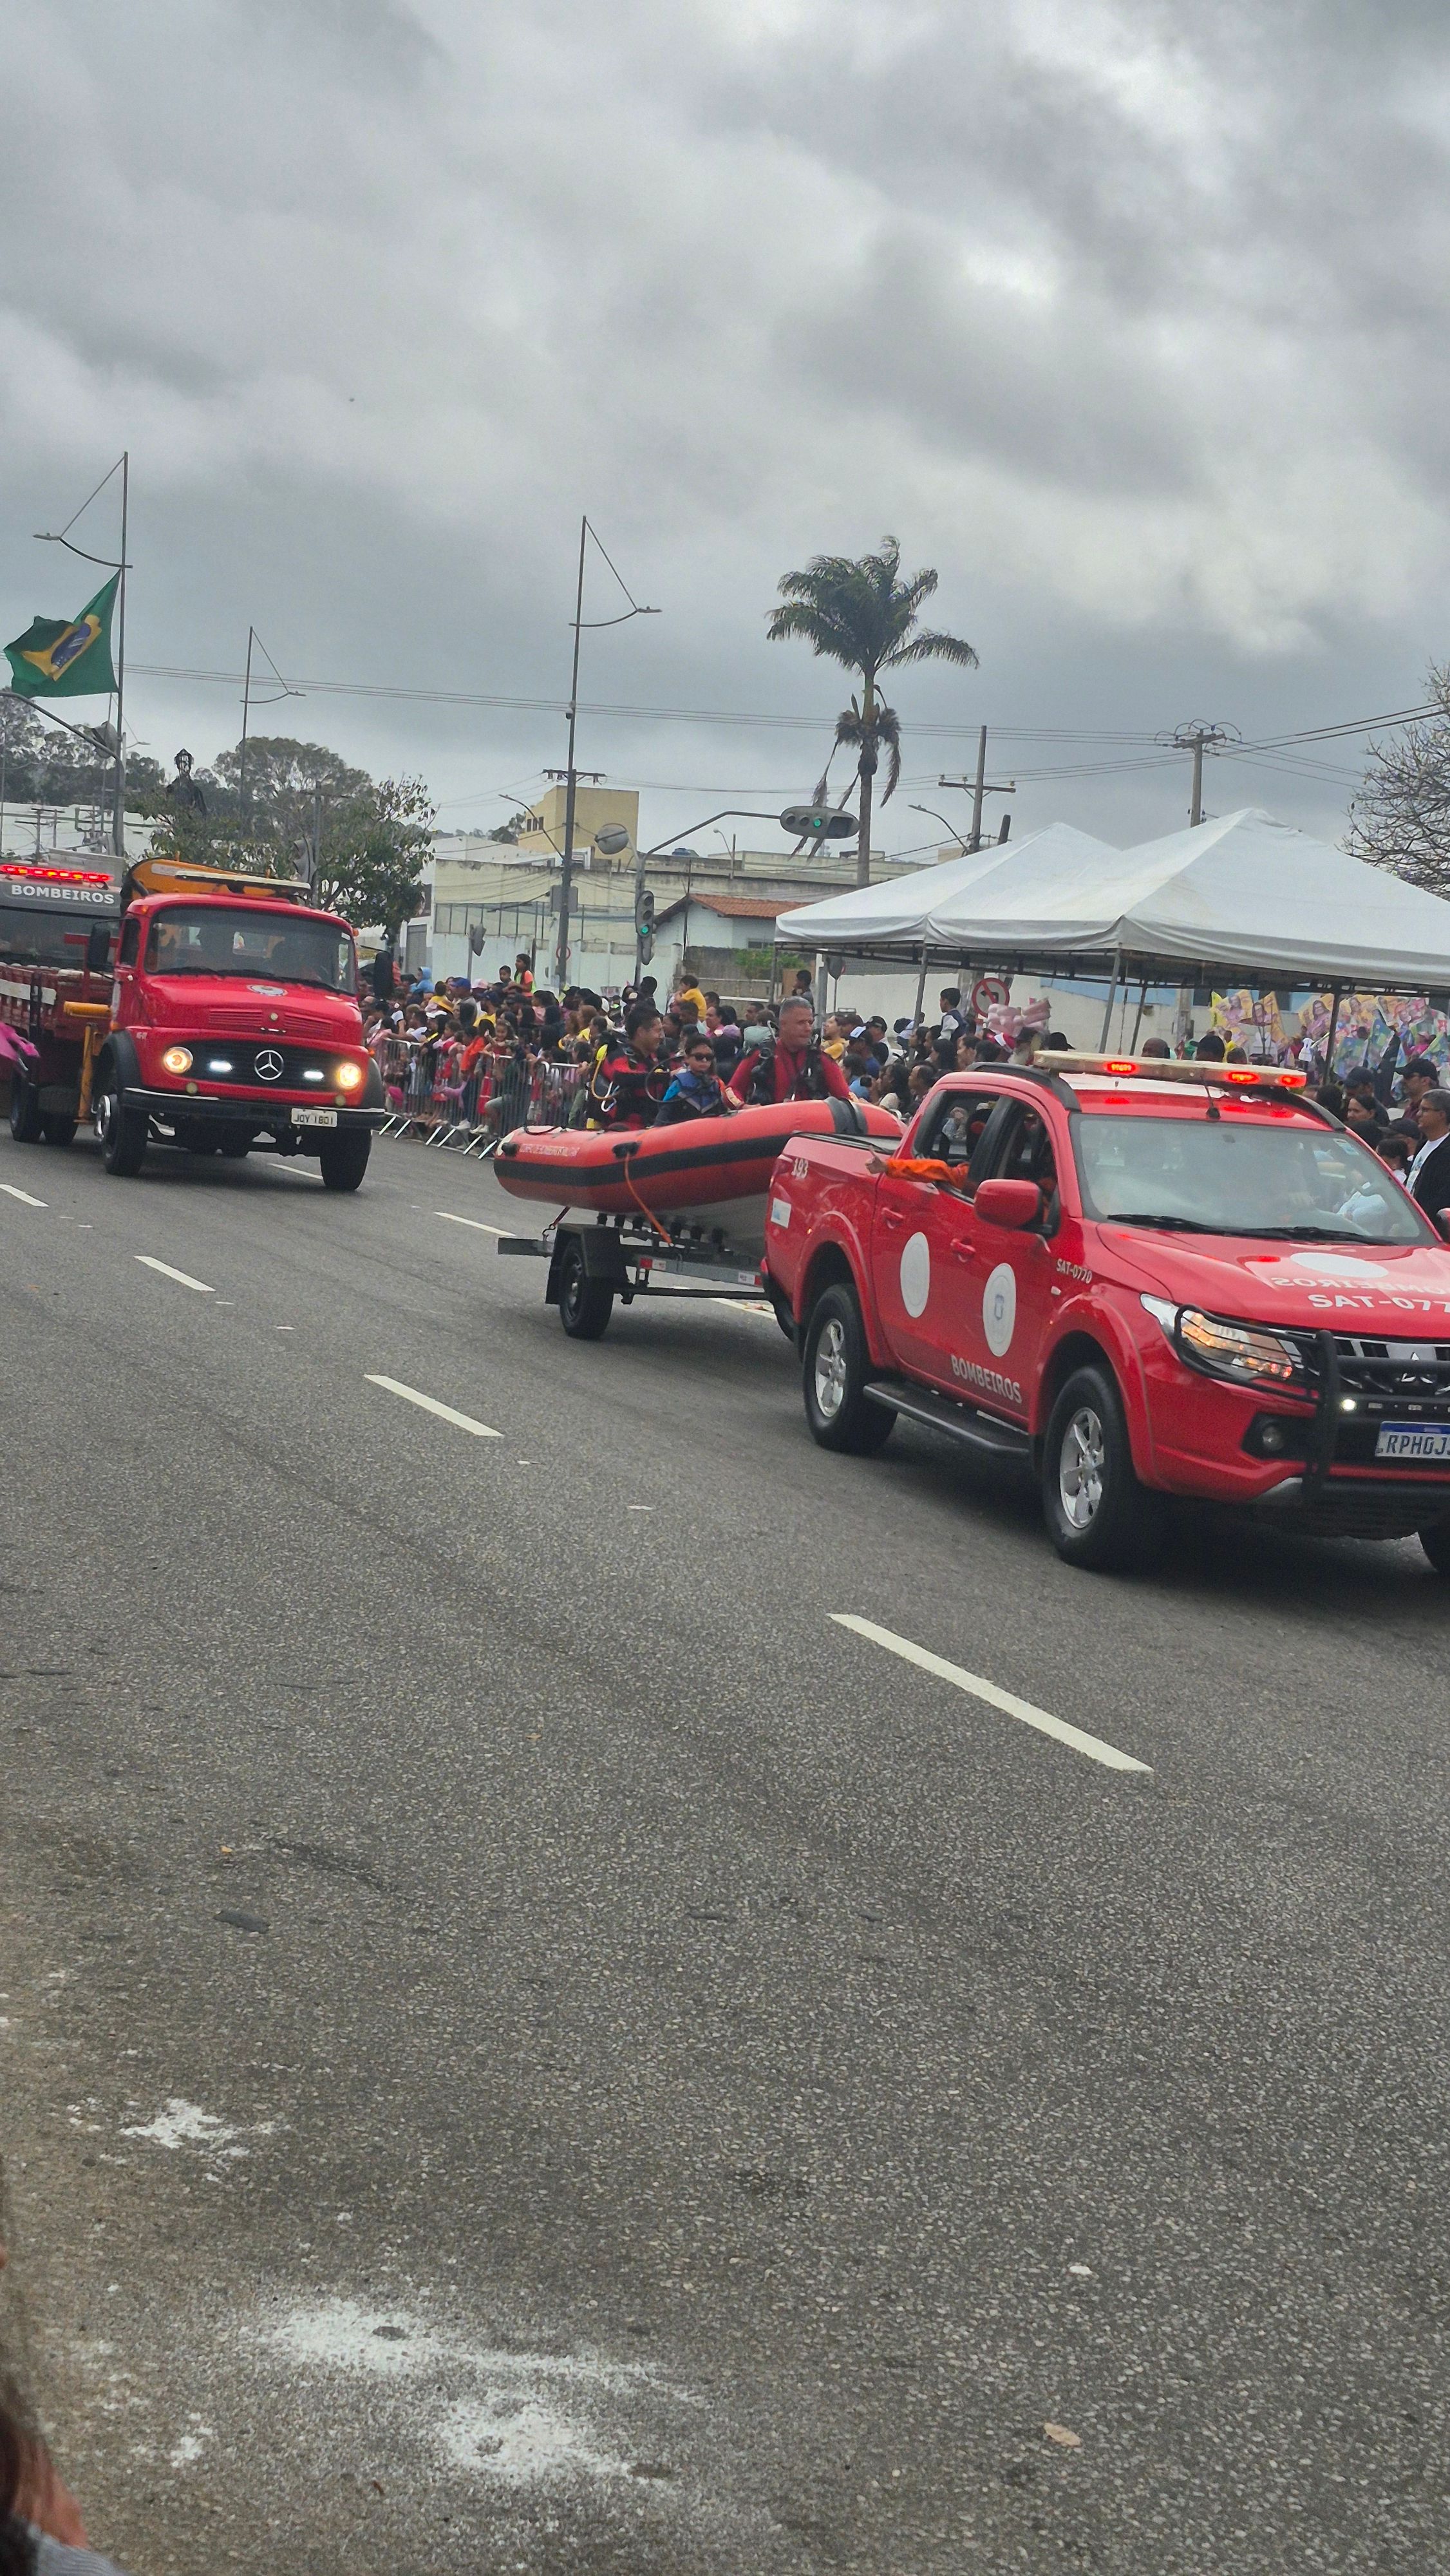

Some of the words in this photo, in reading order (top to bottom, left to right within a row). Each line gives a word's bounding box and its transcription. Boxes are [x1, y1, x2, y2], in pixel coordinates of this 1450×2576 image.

[12, 885, 114, 904] BOMBEIROS
[791, 1158, 809, 1179] 193
[1057, 1258, 1093, 1284] SAT-0770
[1308, 1294, 1450, 1313] SAT-077
[951, 1354, 1022, 1404] BOMBEIROS
